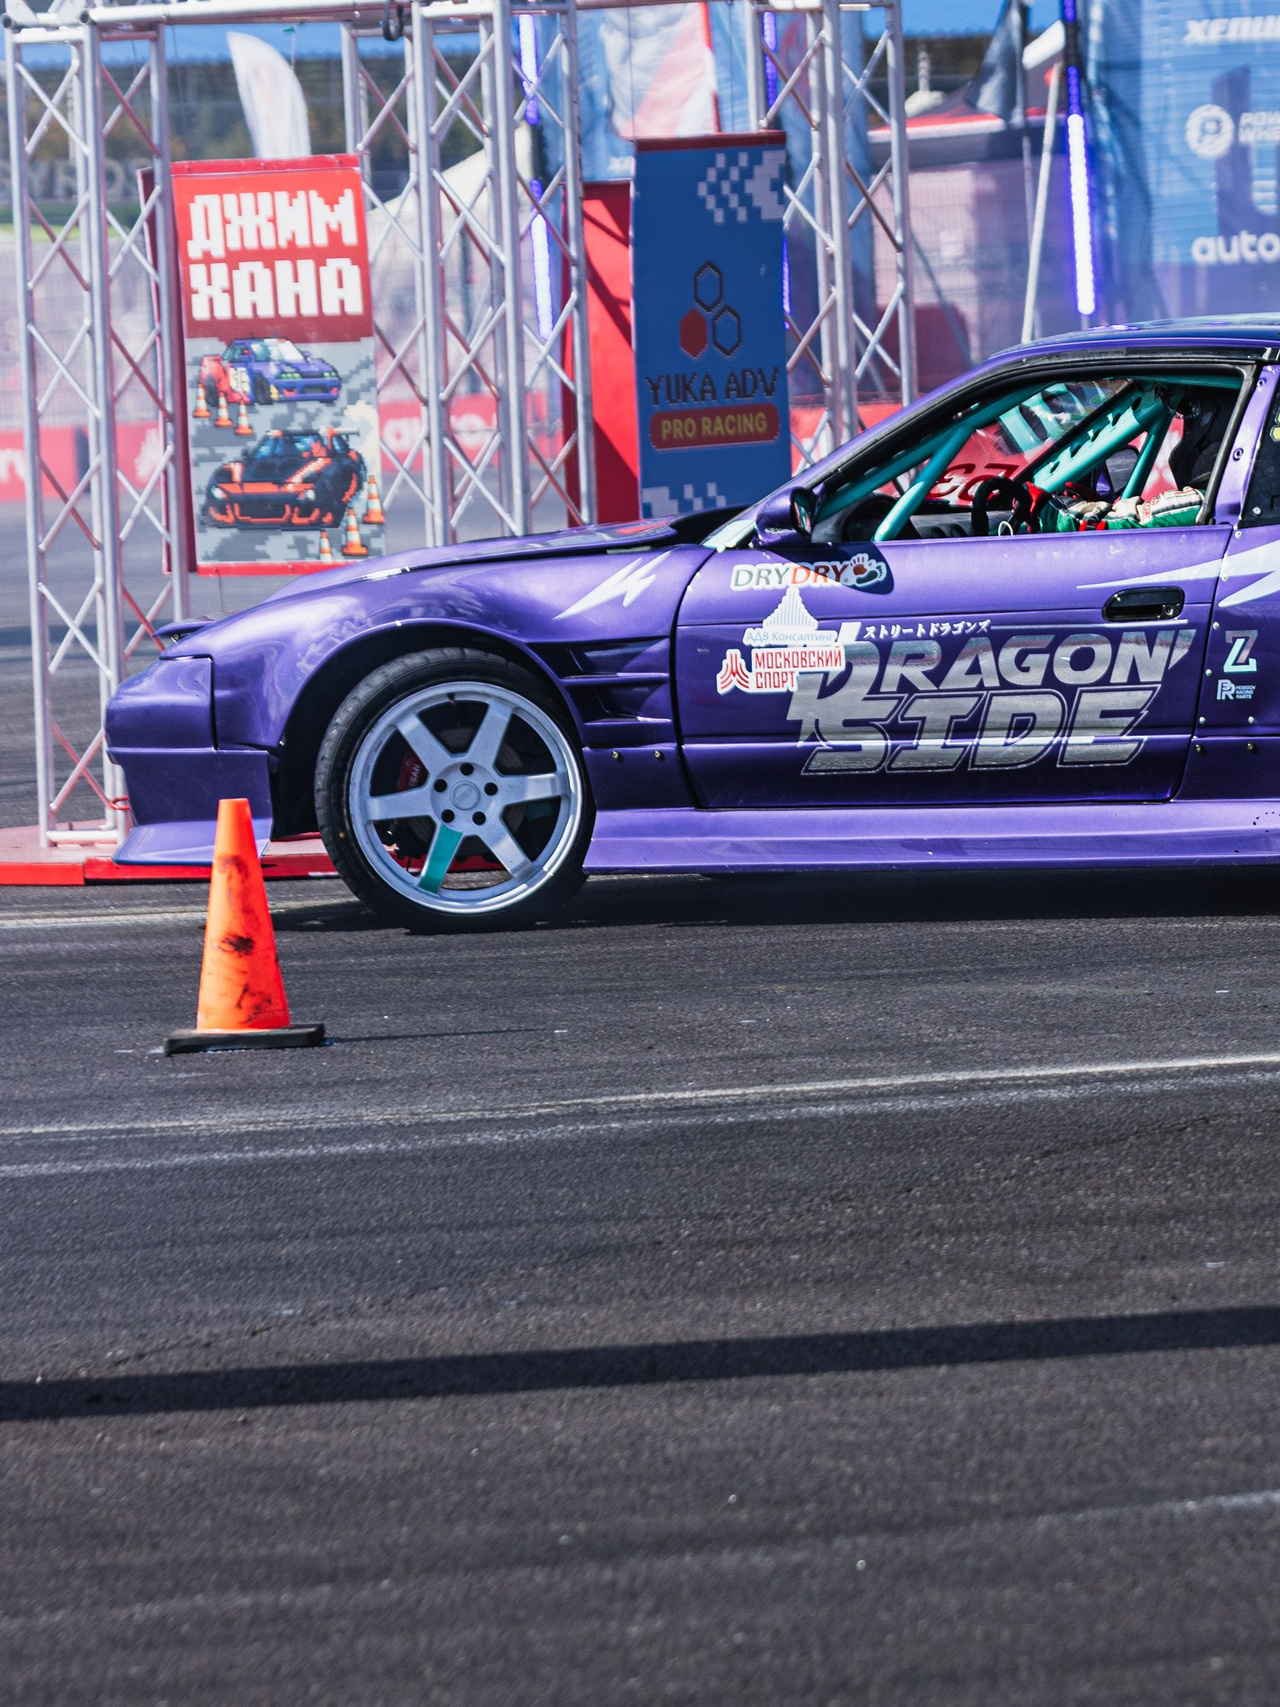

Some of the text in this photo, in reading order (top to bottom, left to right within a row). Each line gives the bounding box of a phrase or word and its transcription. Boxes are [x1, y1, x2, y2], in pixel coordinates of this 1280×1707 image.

[187, 188, 359, 259] ДЖИМ
[188, 257, 365, 322] ХАНА
[645, 366, 780, 407] YUKA ADV
[660, 411, 768, 440] PRO RACING
[771, 631, 835, 643] Консалтинг
[754, 645, 843, 670] МОСКОВСКИЙ
[754, 670, 797, 690] СПОРТ
[800, 685, 1162, 776] SIDE
